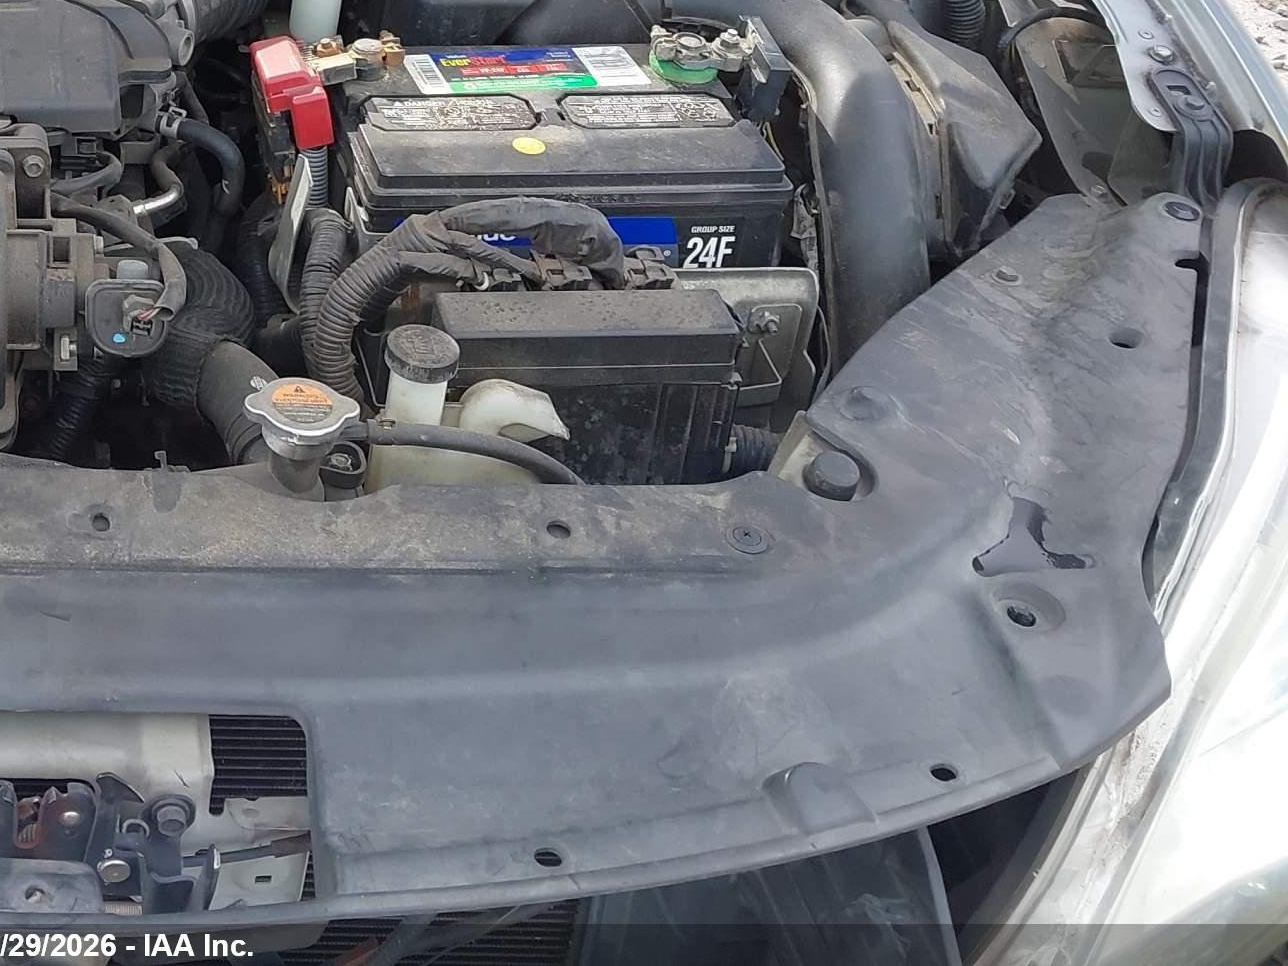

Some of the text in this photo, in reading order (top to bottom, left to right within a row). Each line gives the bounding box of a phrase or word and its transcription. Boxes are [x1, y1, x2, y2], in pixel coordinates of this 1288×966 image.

[691, 225, 736, 234] GROUP SIZE
[682, 235, 736, 269] 24F
